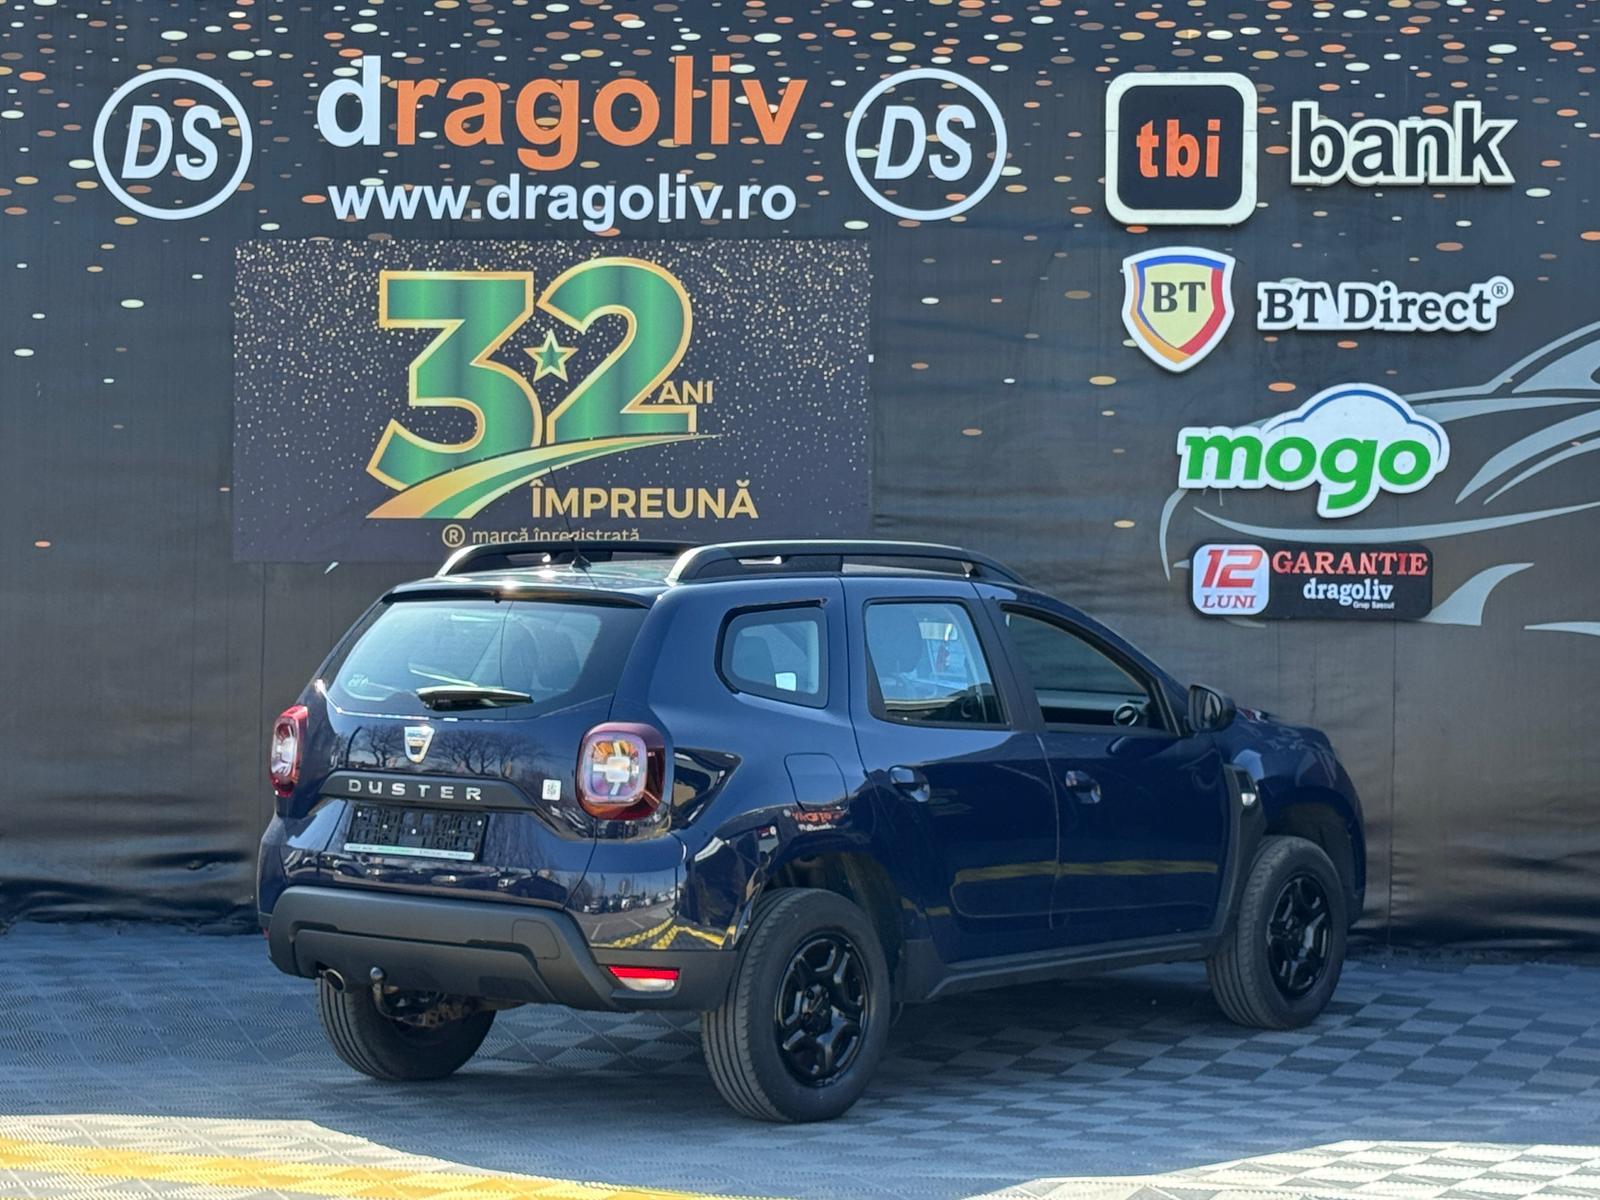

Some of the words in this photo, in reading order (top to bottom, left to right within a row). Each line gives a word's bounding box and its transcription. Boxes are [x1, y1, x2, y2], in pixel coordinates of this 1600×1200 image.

[317, 55, 808, 171] dragoliv
[121, 104, 222, 182] DS
[874, 104, 977, 182] DS
[1136, 119, 1220, 178] tbi
[1297, 105, 1511, 183] bank
[327, 173, 797, 232] www.dragoliv.ro
[1151, 281, 1206, 314] BT
[1263, 288, 1328, 324] BT
[366, 256, 697, 491] 32
[658, 380, 714, 404] ANI
[1185, 435, 1432, 510] mogo
[529, 479, 759, 519] ÎMPREUNĂ
[472, 527, 528, 544] marcă
[1201, 549, 1264, 588] 12
[1272, 550, 1429, 576] GARANTIE
[1202, 594, 1257, 609] LUNI
[1303, 578, 1394, 606] dragoliv
[348, 779, 482, 801] DUSTER
